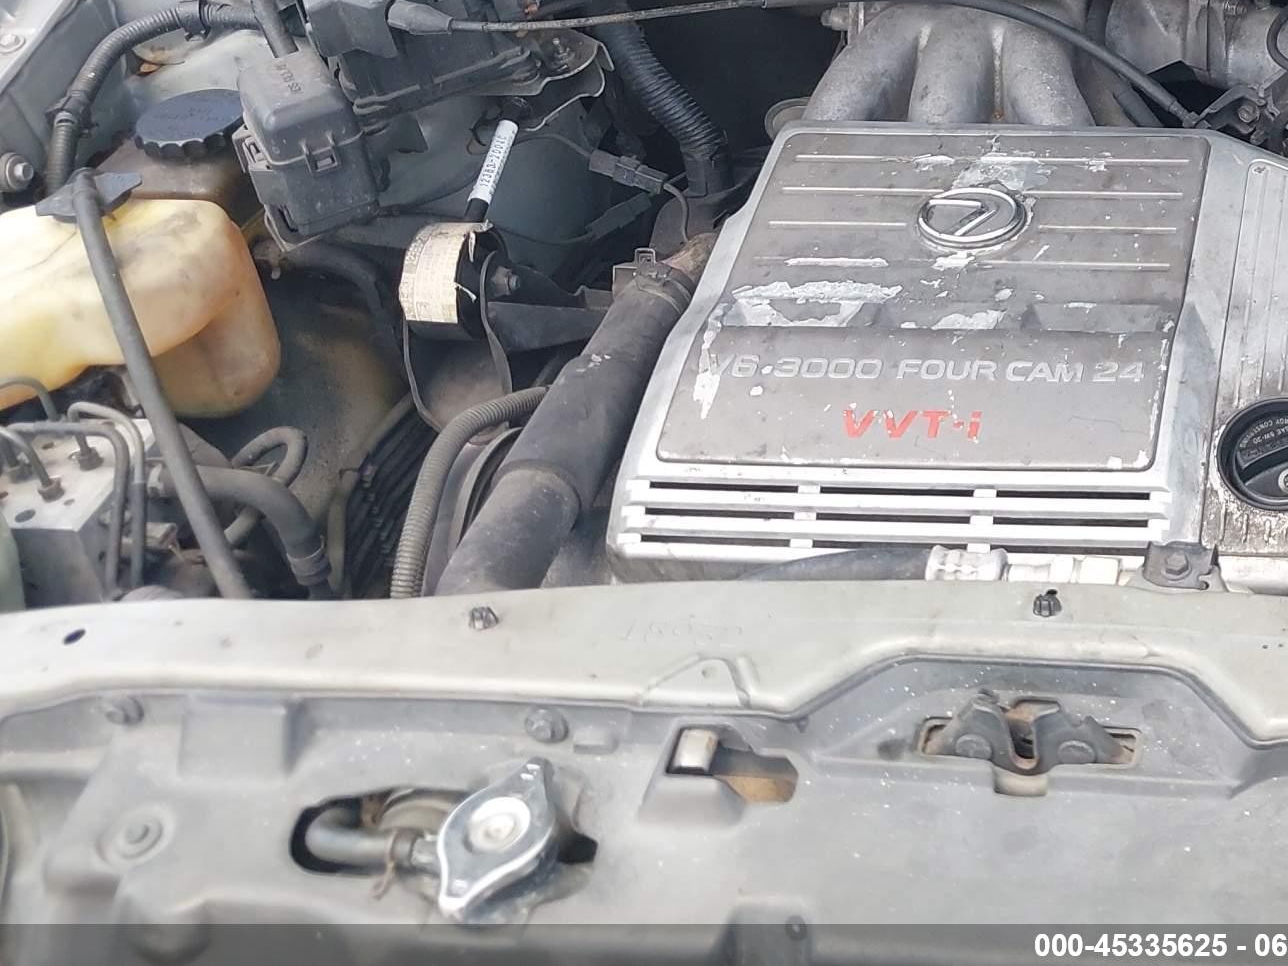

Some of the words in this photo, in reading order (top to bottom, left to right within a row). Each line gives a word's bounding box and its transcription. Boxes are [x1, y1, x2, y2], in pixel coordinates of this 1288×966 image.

[772, 357, 883, 380] 3000
[896, 359, 997, 381] FOUR
[1005, 361, 1084, 383] CAM
[1092, 361, 1145, 384] 24
[842, 408, 983, 442] VVT-i
